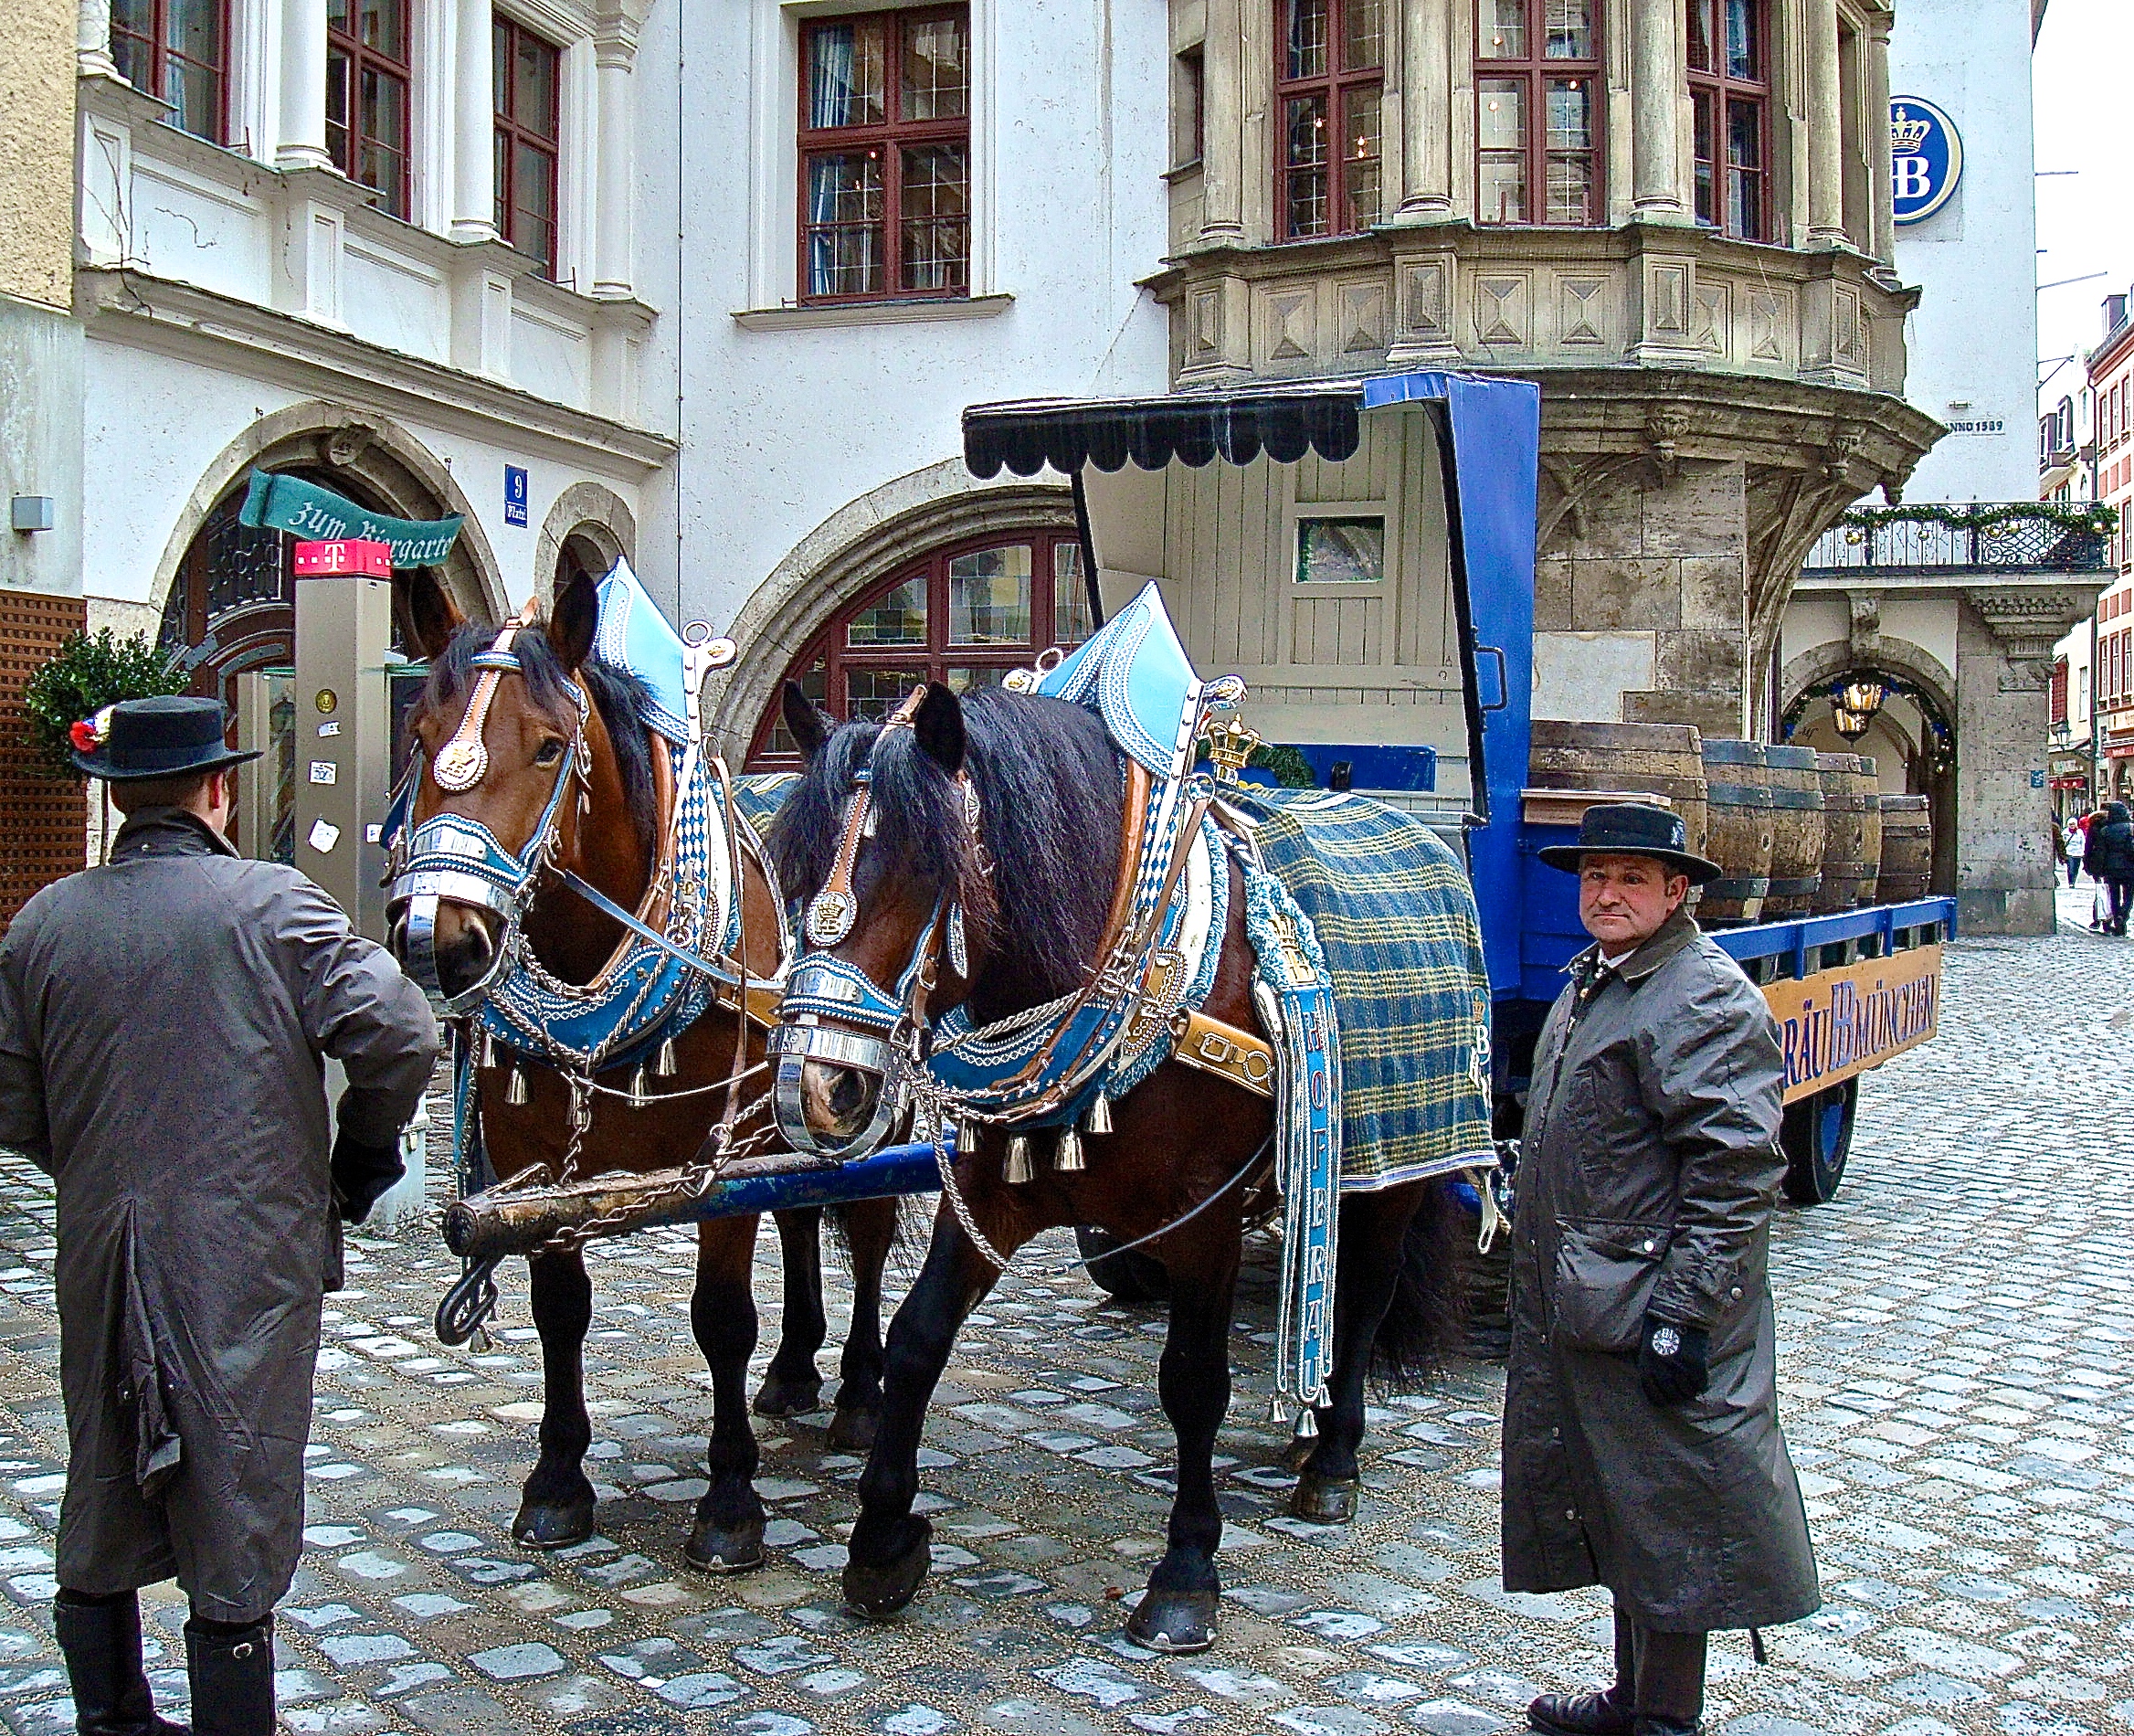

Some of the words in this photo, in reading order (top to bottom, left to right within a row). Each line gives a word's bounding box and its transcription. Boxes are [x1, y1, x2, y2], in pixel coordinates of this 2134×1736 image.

[1893, 156, 1931, 198] B
[1945, 421, 1973, 432] NNO
[1975, 420, 2003, 432] 1589
[514, 474, 523, 499] 9
[324, 543, 344, 572] T
[1853, 973, 1935, 1062] MÜNCHEN
